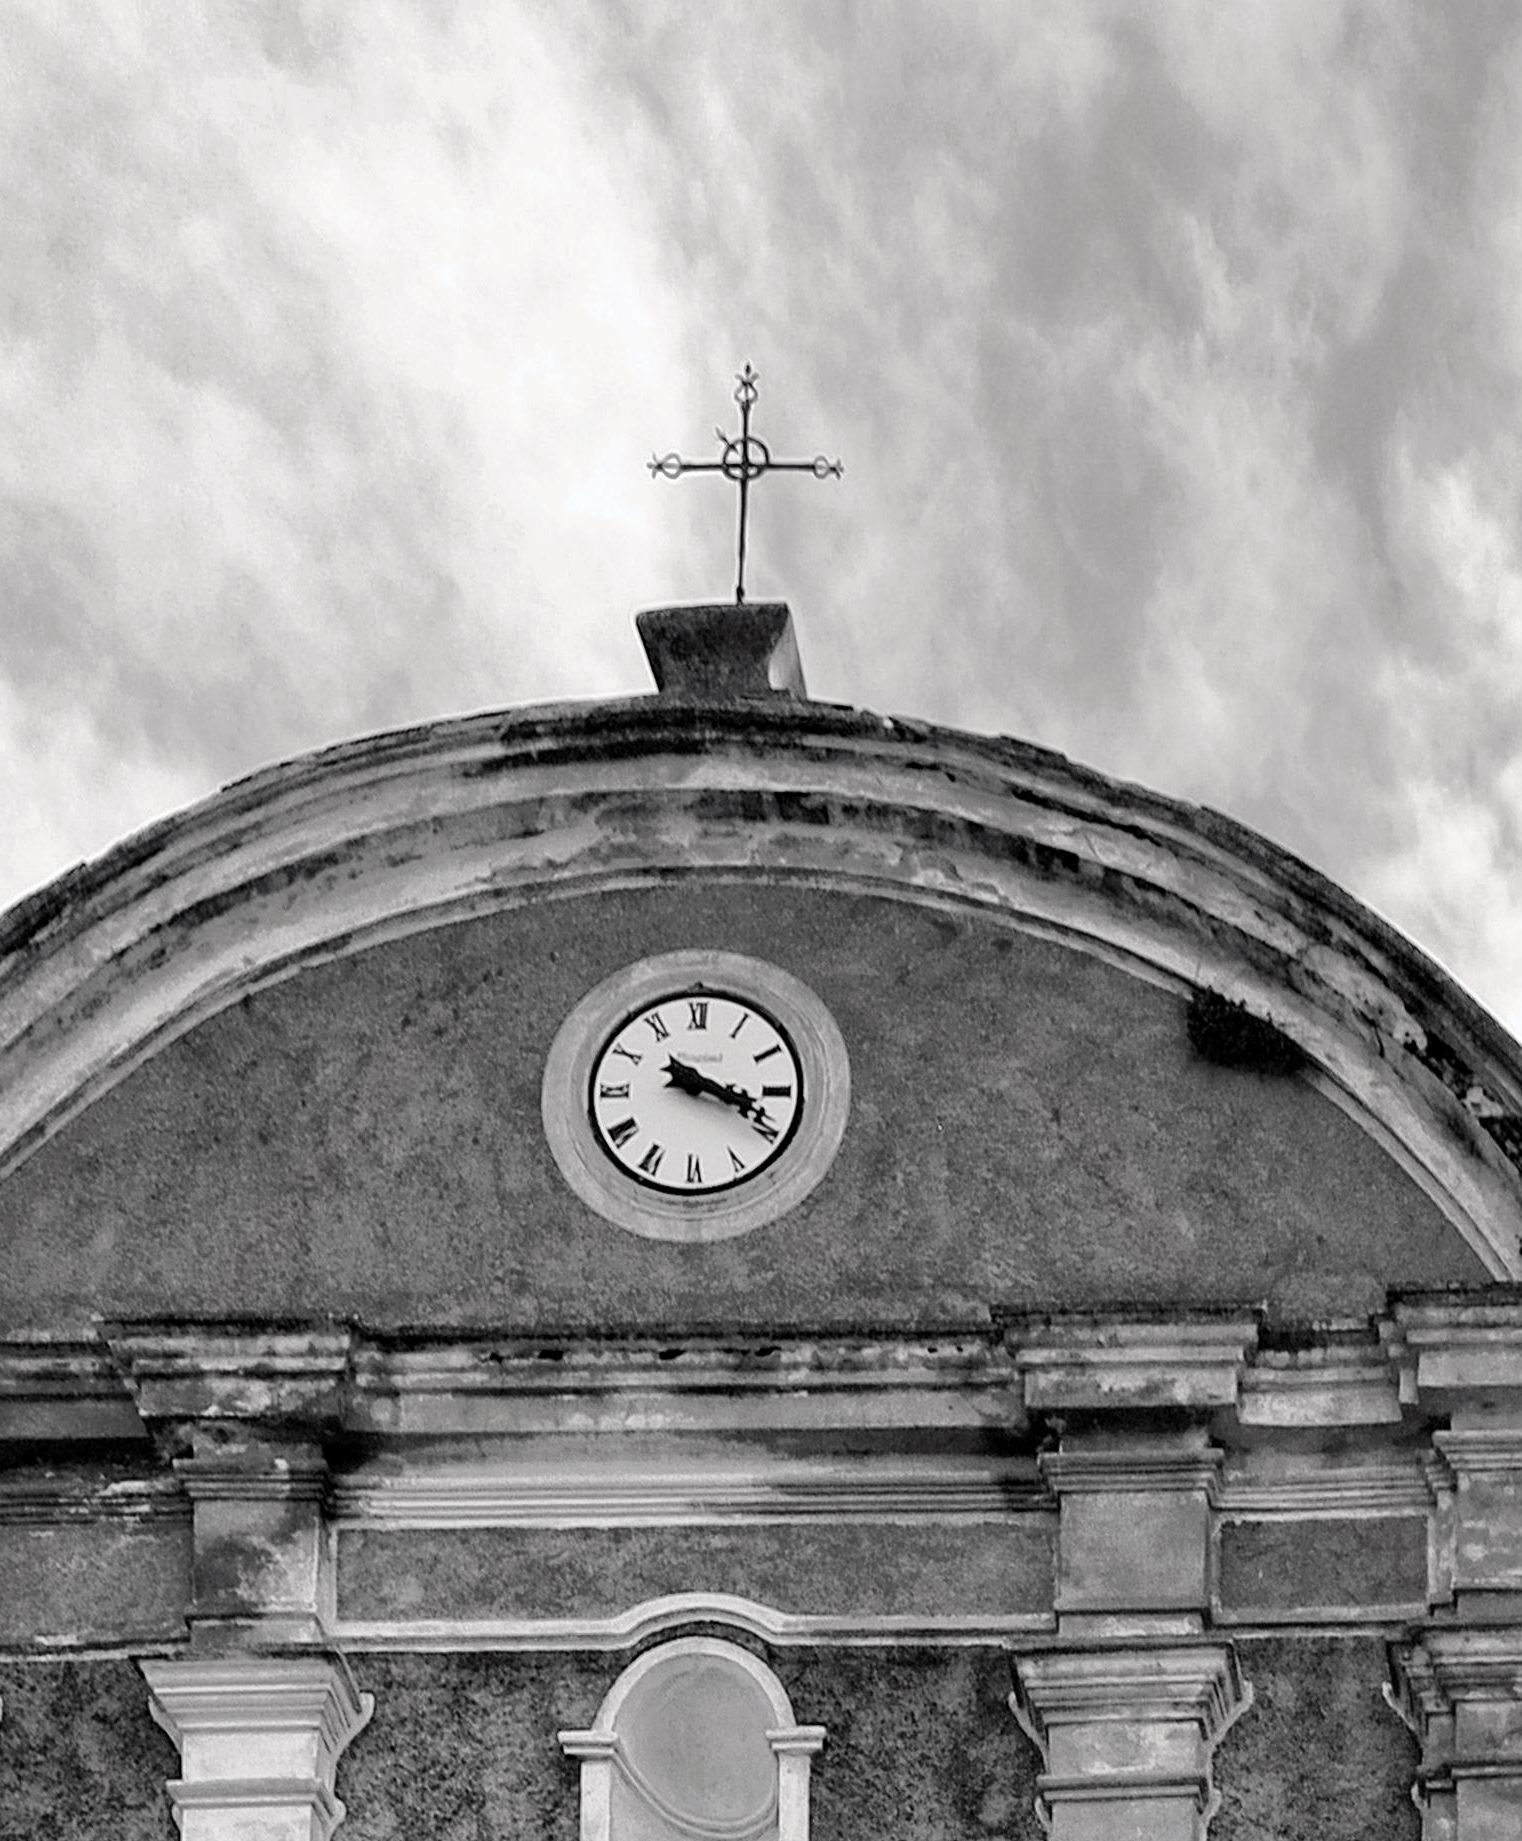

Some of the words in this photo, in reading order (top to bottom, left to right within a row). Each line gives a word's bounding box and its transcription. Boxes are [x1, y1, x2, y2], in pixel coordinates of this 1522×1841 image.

[644, 1012, 670, 1042] XI
[687, 1002, 708, 1030] XII
[611, 1043, 642, 1065] X
[600, 1083, 629, 1098] IX
[638, 1143, 666, 1176] VII
[687, 1153, 702, 1183] VI
[726, 1145, 745, 1173] V
